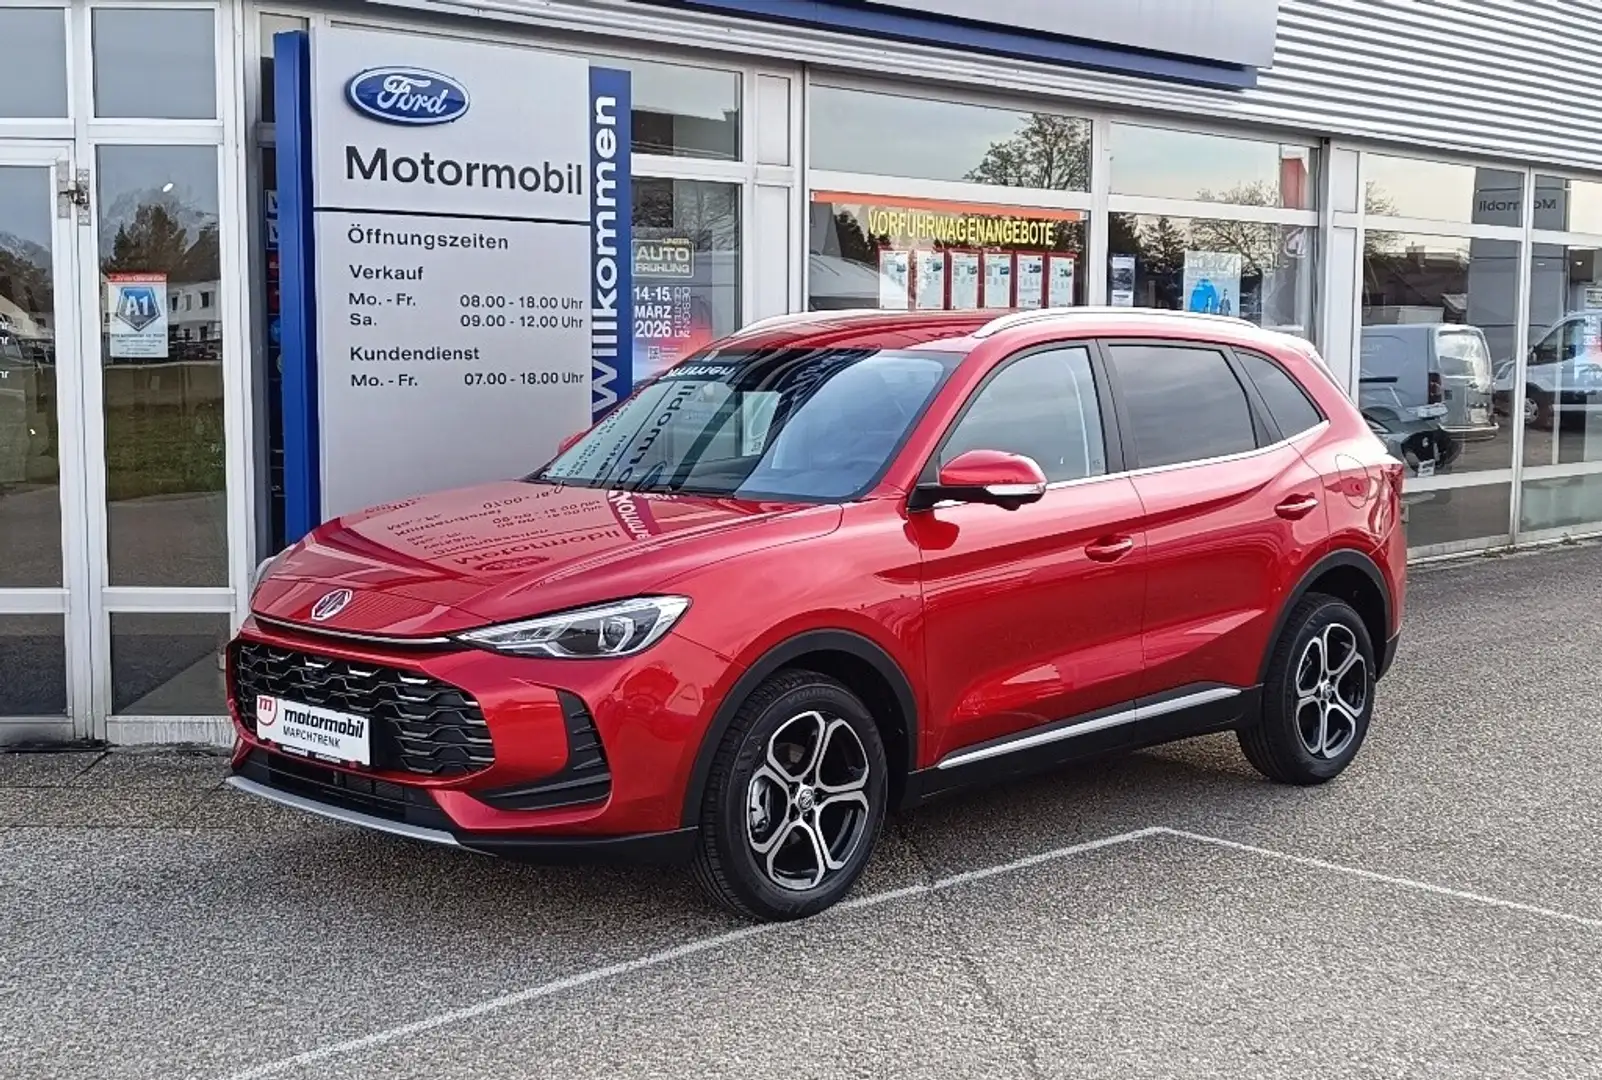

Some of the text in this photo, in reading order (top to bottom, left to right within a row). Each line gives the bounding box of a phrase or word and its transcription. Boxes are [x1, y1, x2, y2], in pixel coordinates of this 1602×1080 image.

[376, 75, 449, 115] Ford
[346, 146, 583, 195] Motormobil
[868, 209, 1055, 245] VORFÜHRWAGENANGEBOTE
[347, 224, 509, 250] Öffnungszeiten
[591, 95, 617, 413] Willkommen
[635, 246, 690, 261] AUTO
[349, 264, 423, 281] Verkauf
[125, 295, 149, 316] A1
[349, 292, 382, 306] Mo.
[396, 293, 416, 306] Fr.
[460, 295, 505, 308] 08.00
[519, 296, 558, 309] 18.00
[561, 297, 583, 310] Uhr
[350, 313, 377, 326] Sa.
[460, 315, 505, 328] 09.00
[519, 315, 558, 328] 12.00
[561, 316, 583, 329] Uhr
[634, 320, 673, 338] 2026
[350, 346, 480, 361] Kundendienst
[351, 374, 384, 387] Mo.
[398, 374, 418, 387] Fr.
[464, 372, 507, 385] 07.00
[520, 372, 559, 385] 18.00
[562, 372, 584, 384] Uhr
[284, 707, 364, 739] motormobil
